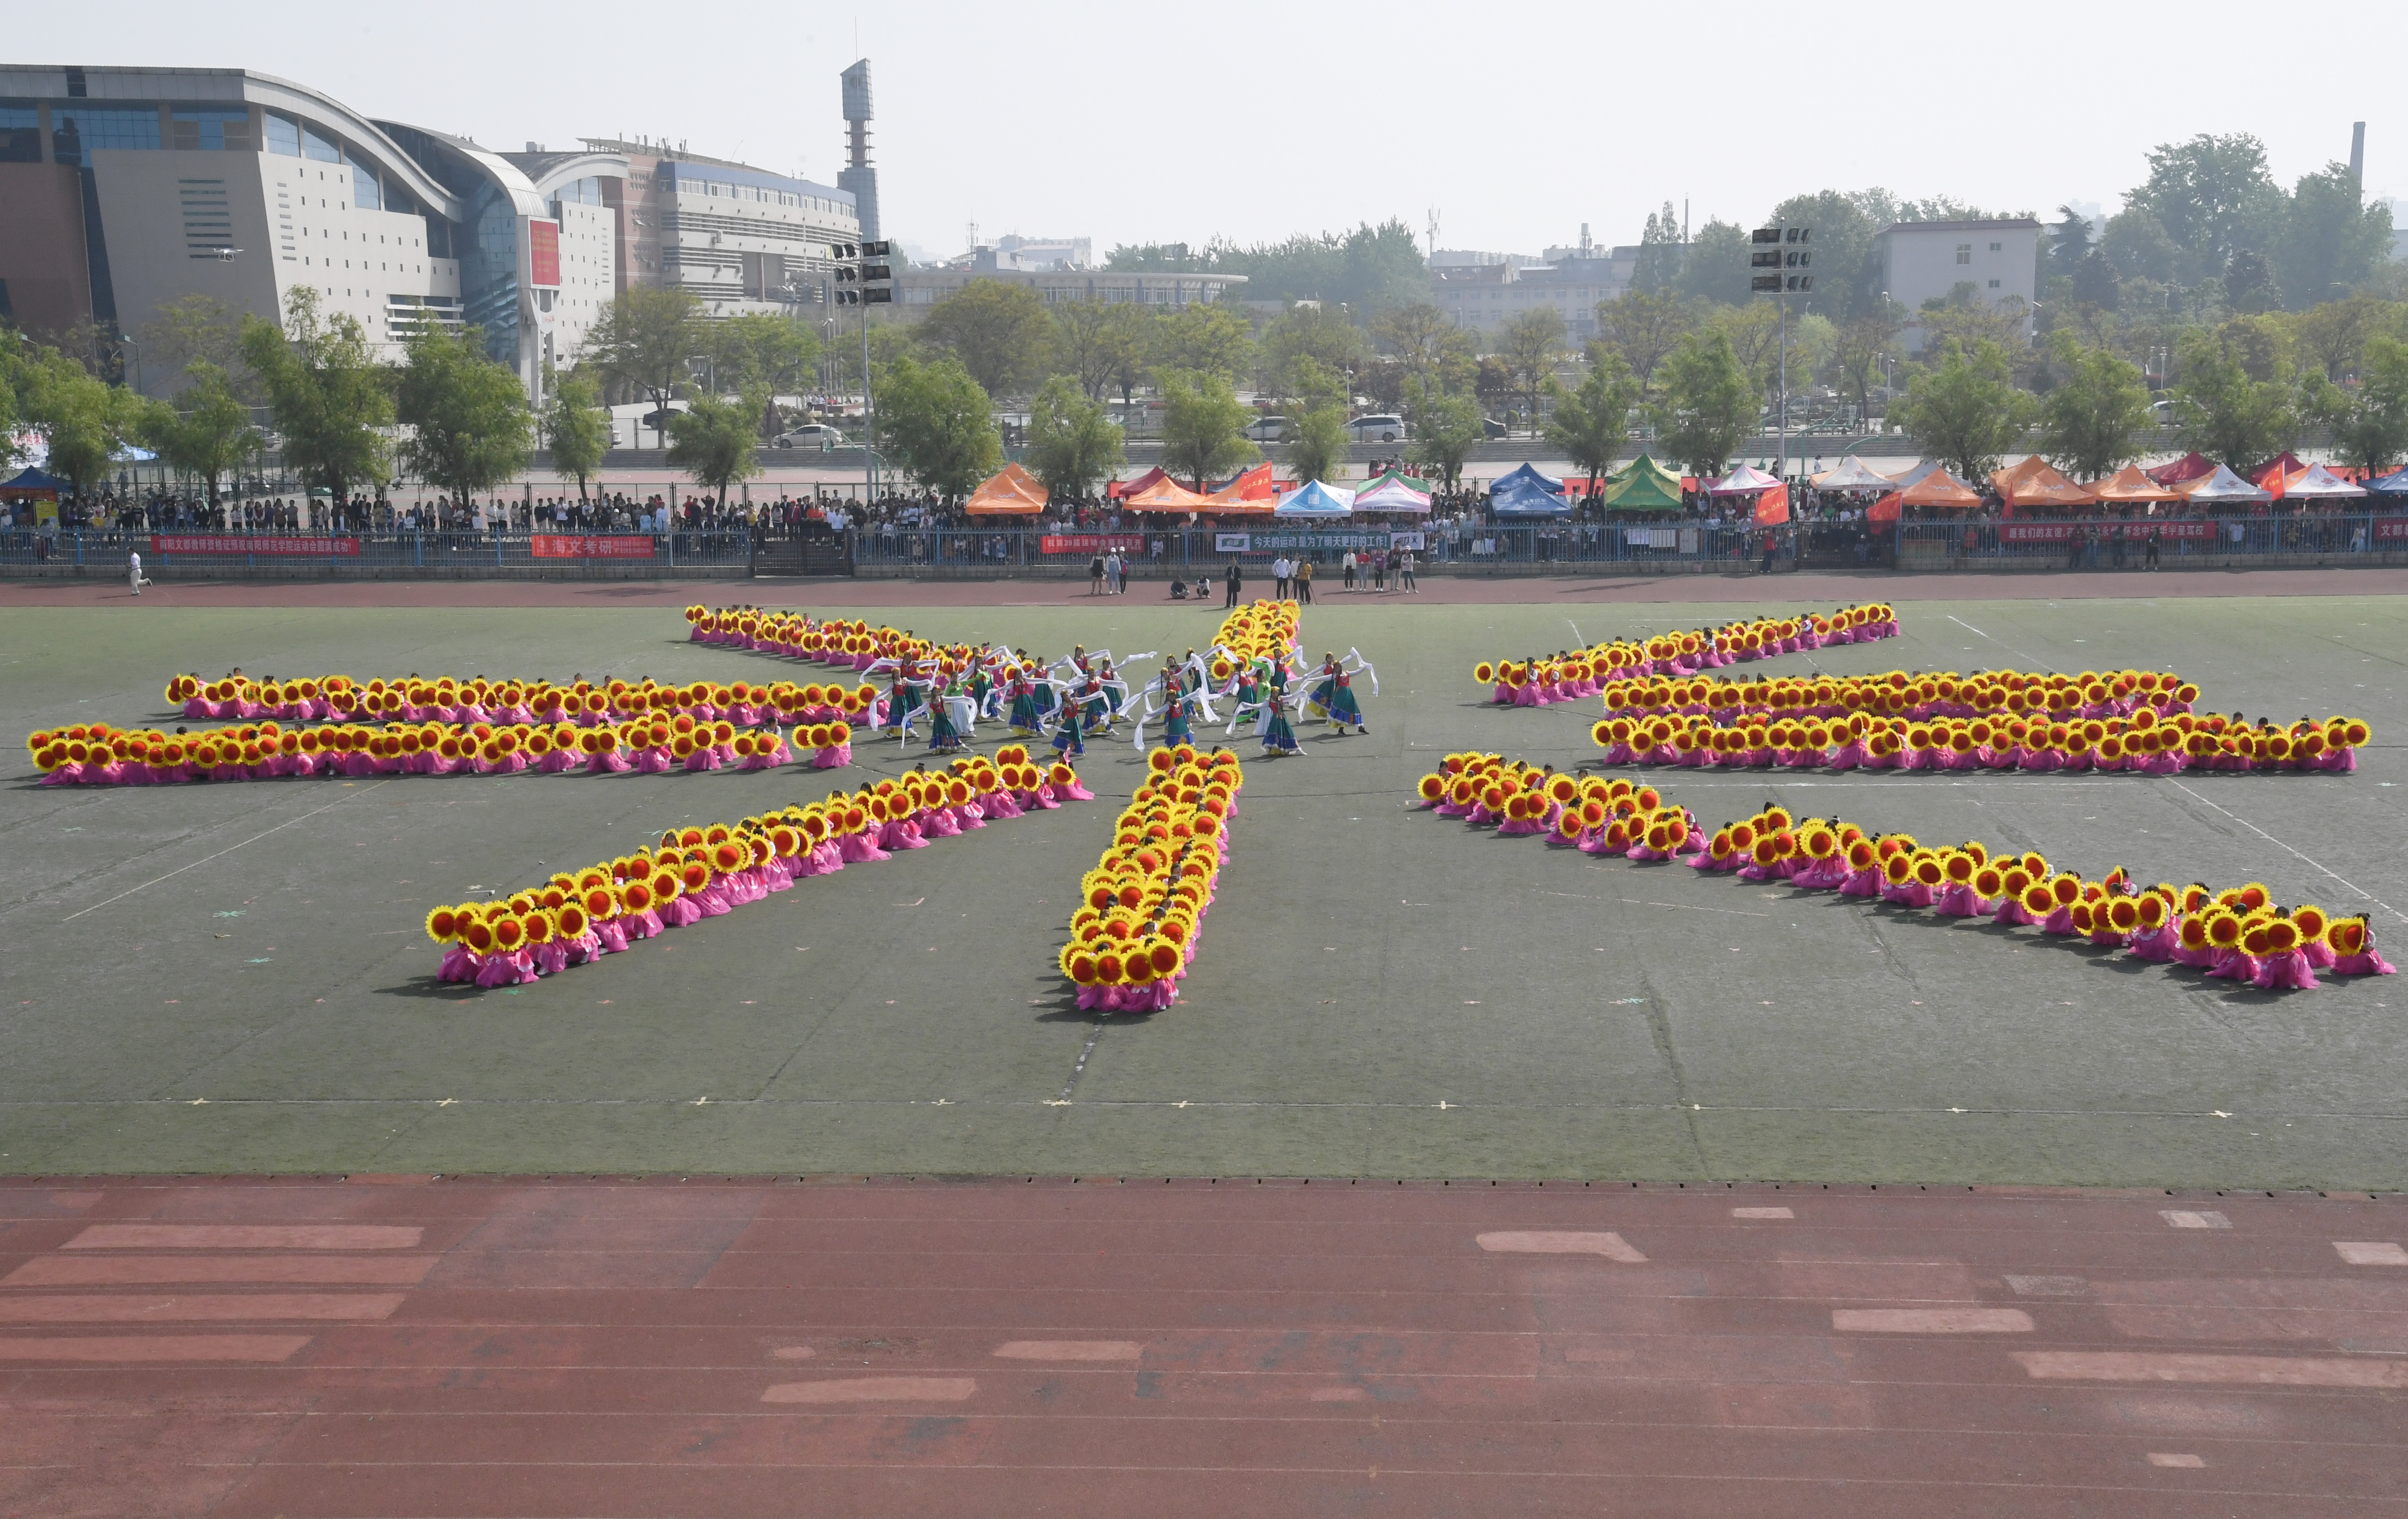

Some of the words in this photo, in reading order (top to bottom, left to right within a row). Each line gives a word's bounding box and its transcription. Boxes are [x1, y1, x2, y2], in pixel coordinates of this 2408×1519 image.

[552, 539, 613, 554] 海文考研
[1047, 539, 1141, 547] 祝第39届运动会顺利召开
